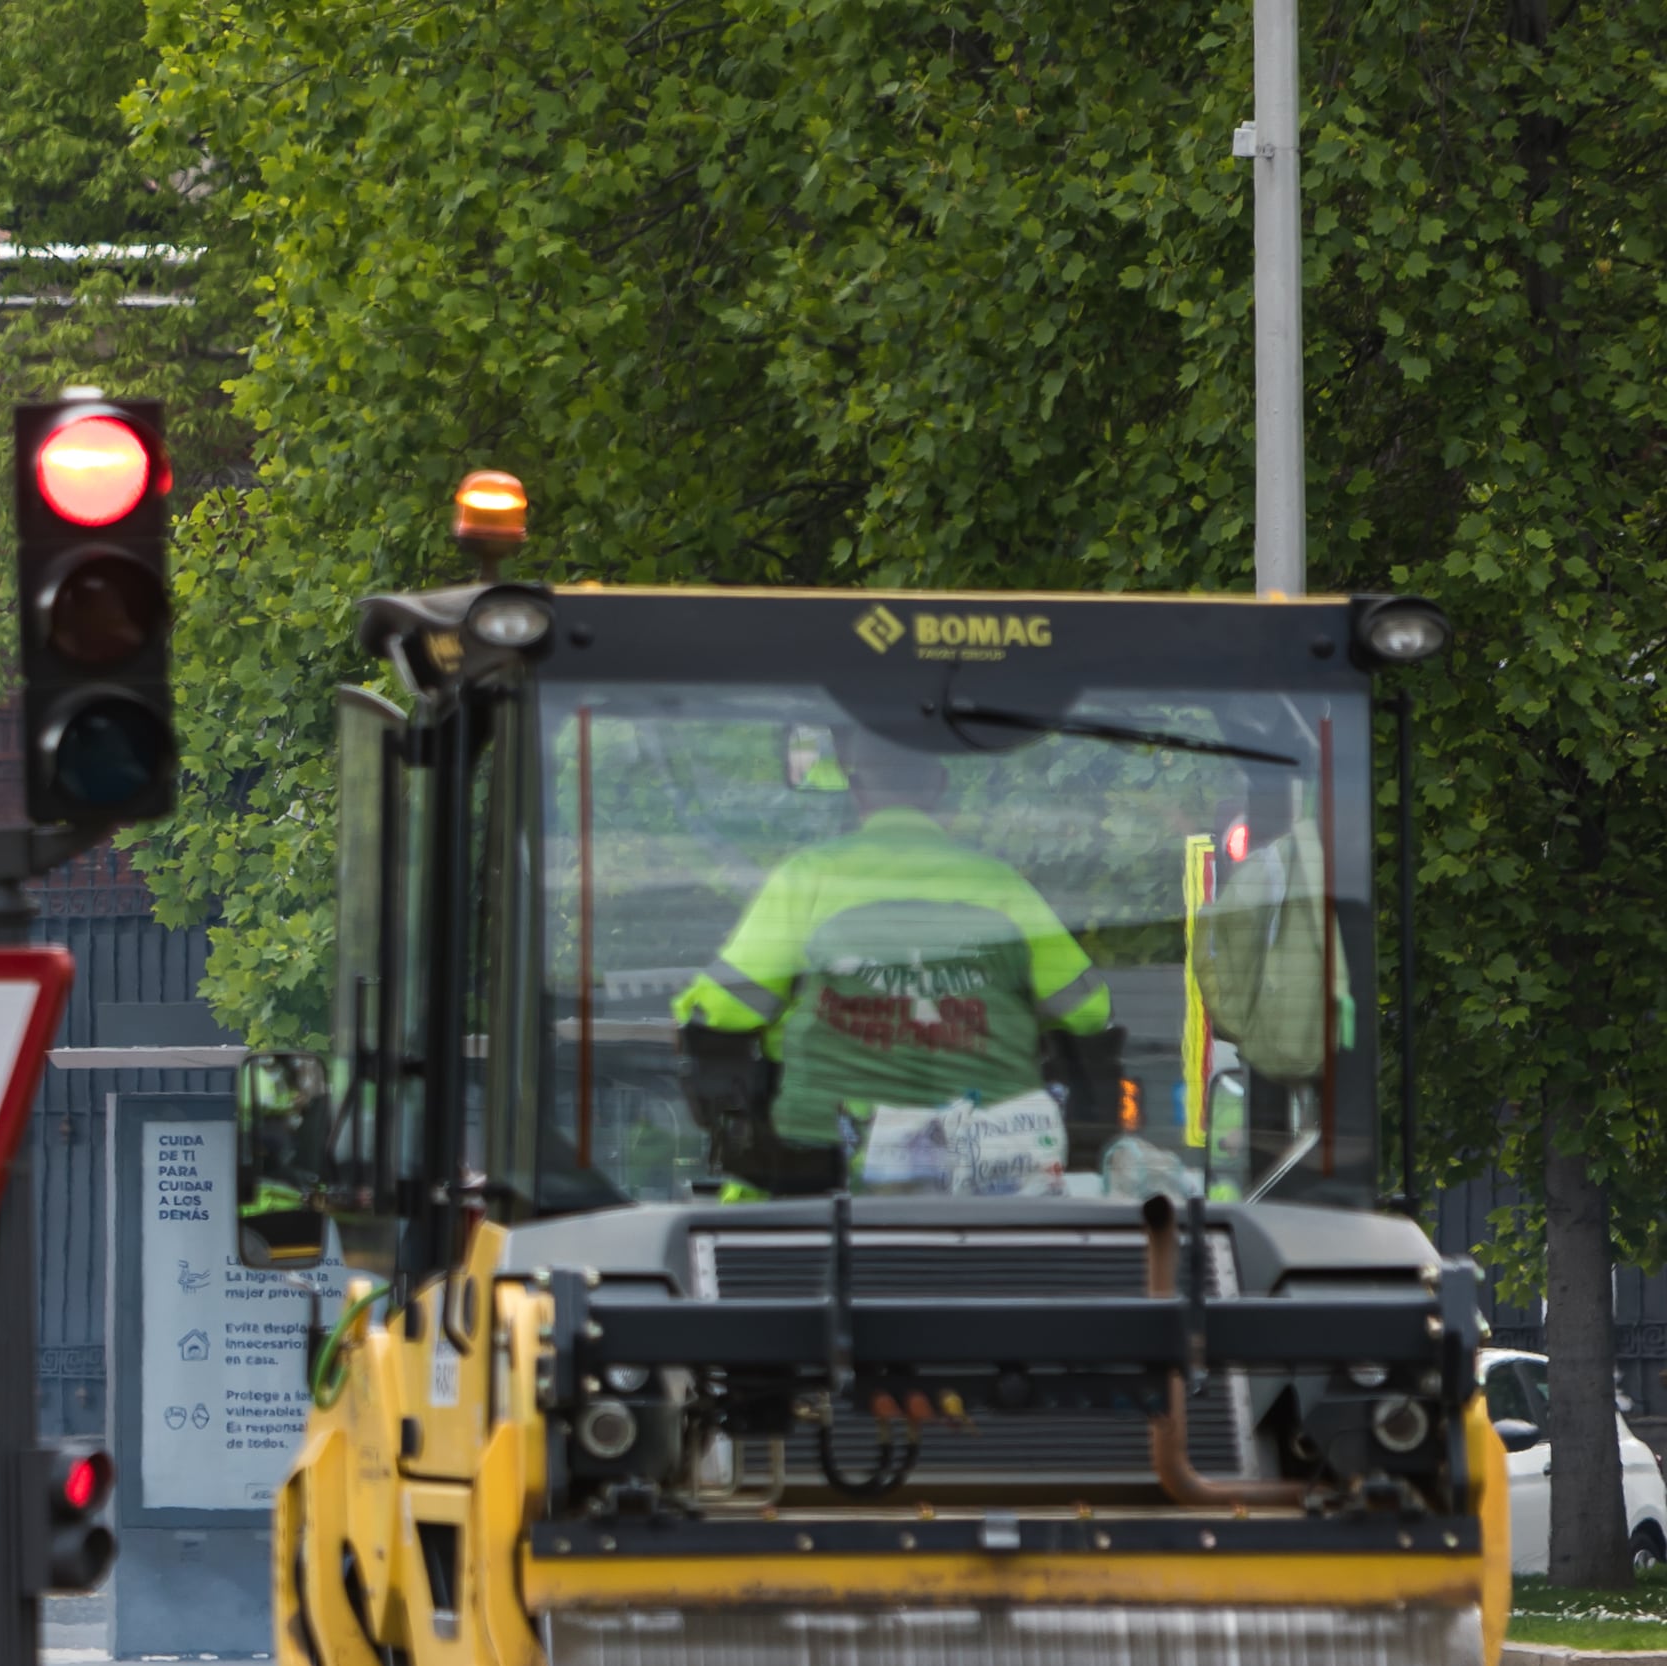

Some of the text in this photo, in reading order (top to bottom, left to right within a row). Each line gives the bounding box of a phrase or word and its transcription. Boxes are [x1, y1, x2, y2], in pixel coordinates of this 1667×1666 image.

[915, 614, 1052, 647] BOMAG
[159, 1135, 204, 1146] CUIDA
[159, 1150, 195, 1161] DE TI
[159, 1166, 197, 1176] PARA
[159, 1181, 213, 1191] CUIDAR
[159, 1196, 201, 1206] A LOS
[159, 1207, 209, 1220] DEMÁS
[226, 1271, 241, 1282] La
[246, 1271, 290, 1283] higien
[317, 1271, 328, 1281] la
[226, 1323, 259, 1333] Evita
[226, 1355, 278, 1365] en casa.
[226, 1390, 280, 1403] Protege
[284, 1393, 290, 1401] a
[226, 1406, 305, 1417] vulnerables.
[227, 1439, 288, 1449] de todos.
